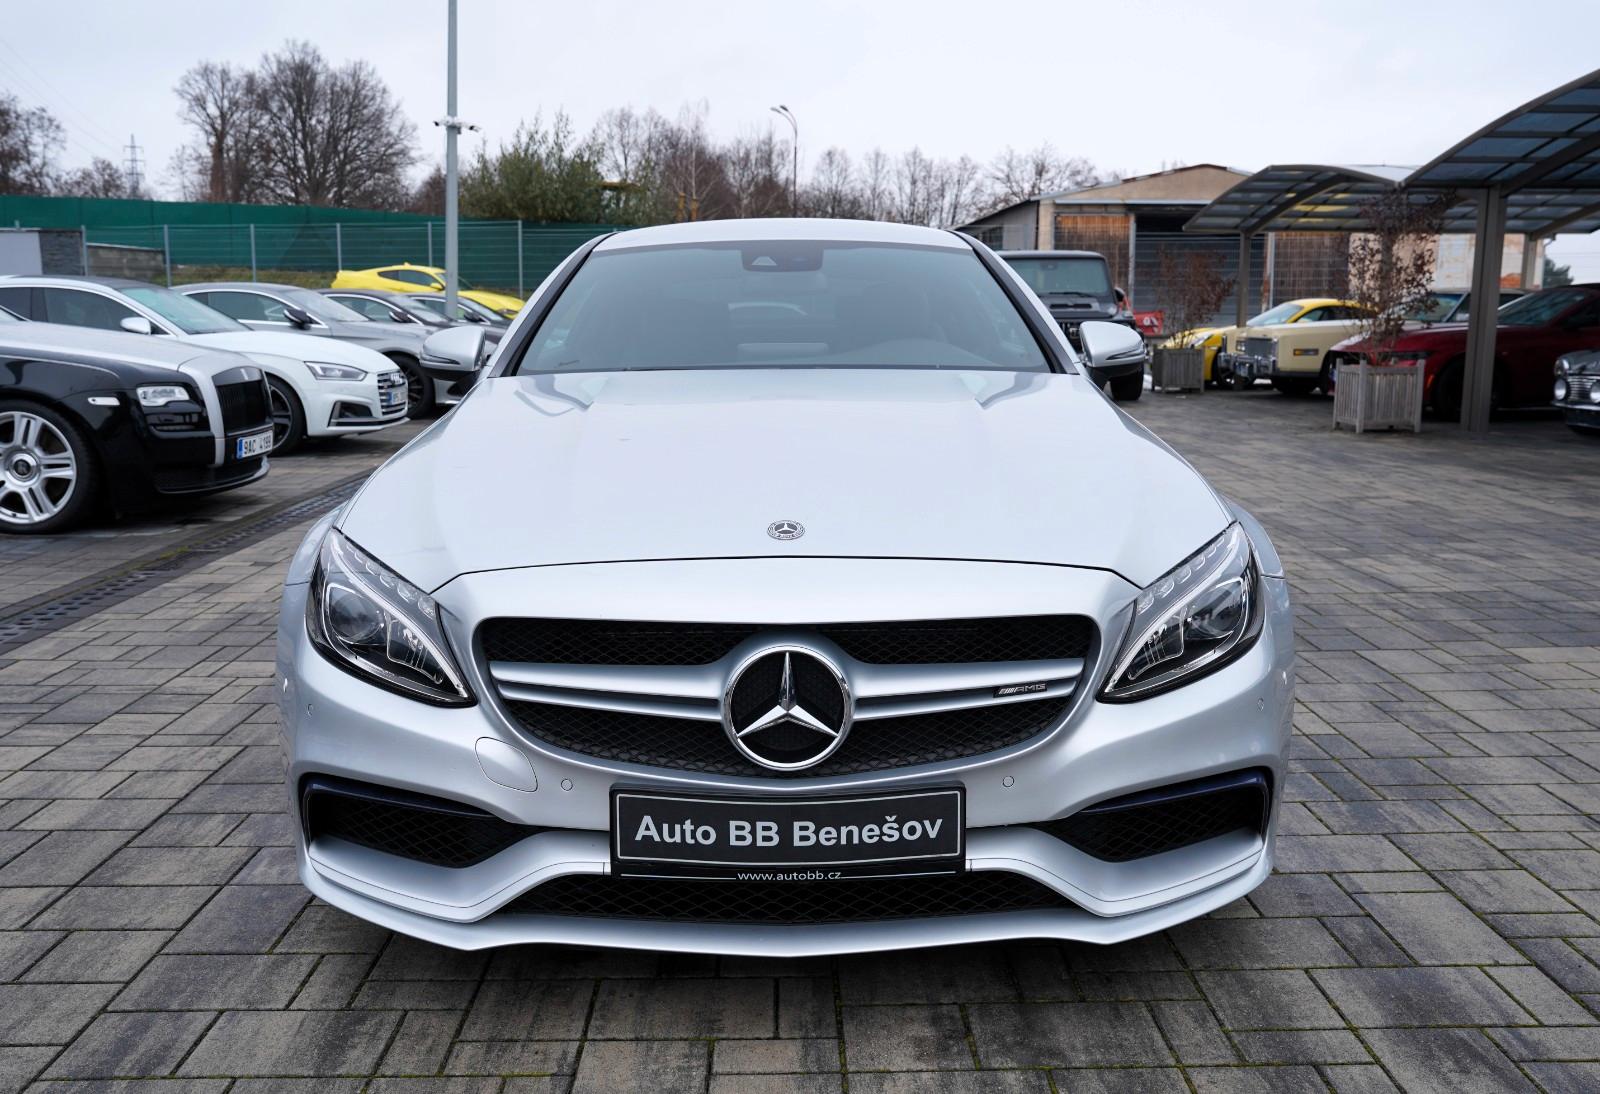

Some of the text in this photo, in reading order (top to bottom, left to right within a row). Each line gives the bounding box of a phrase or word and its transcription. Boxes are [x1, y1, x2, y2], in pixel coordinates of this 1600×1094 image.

[1015, 683, 1046, 692] AMG
[634, 815, 943, 847] Auto BB Benešov
[737, 870, 842, 881] www.autobb.cz
